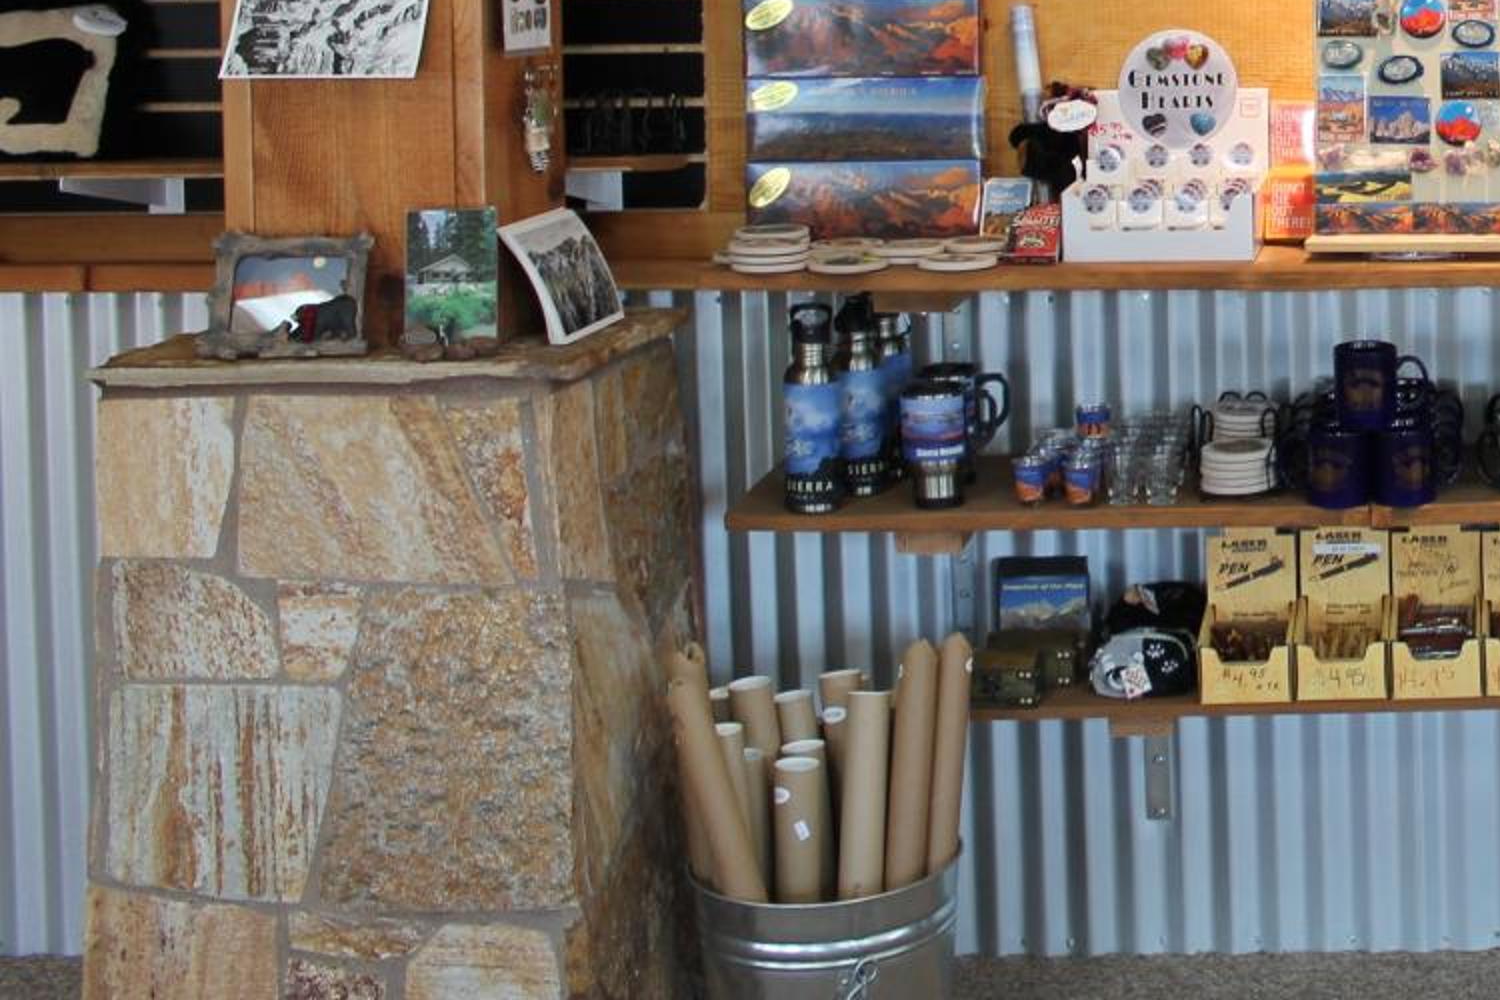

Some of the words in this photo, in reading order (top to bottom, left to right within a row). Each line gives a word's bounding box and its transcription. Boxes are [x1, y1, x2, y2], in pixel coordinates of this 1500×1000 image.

[1127, 69, 1229, 88] GEMSTONE
[1141, 91, 1214, 109] HEARTS
[1315, 531, 1361, 541] LASER
[1401, 535, 1448, 545] LASER
[1220, 539, 1267, 550] LASER
[1313, 553, 1344, 565] PEN
[1218, 562, 1249, 575] PEN
